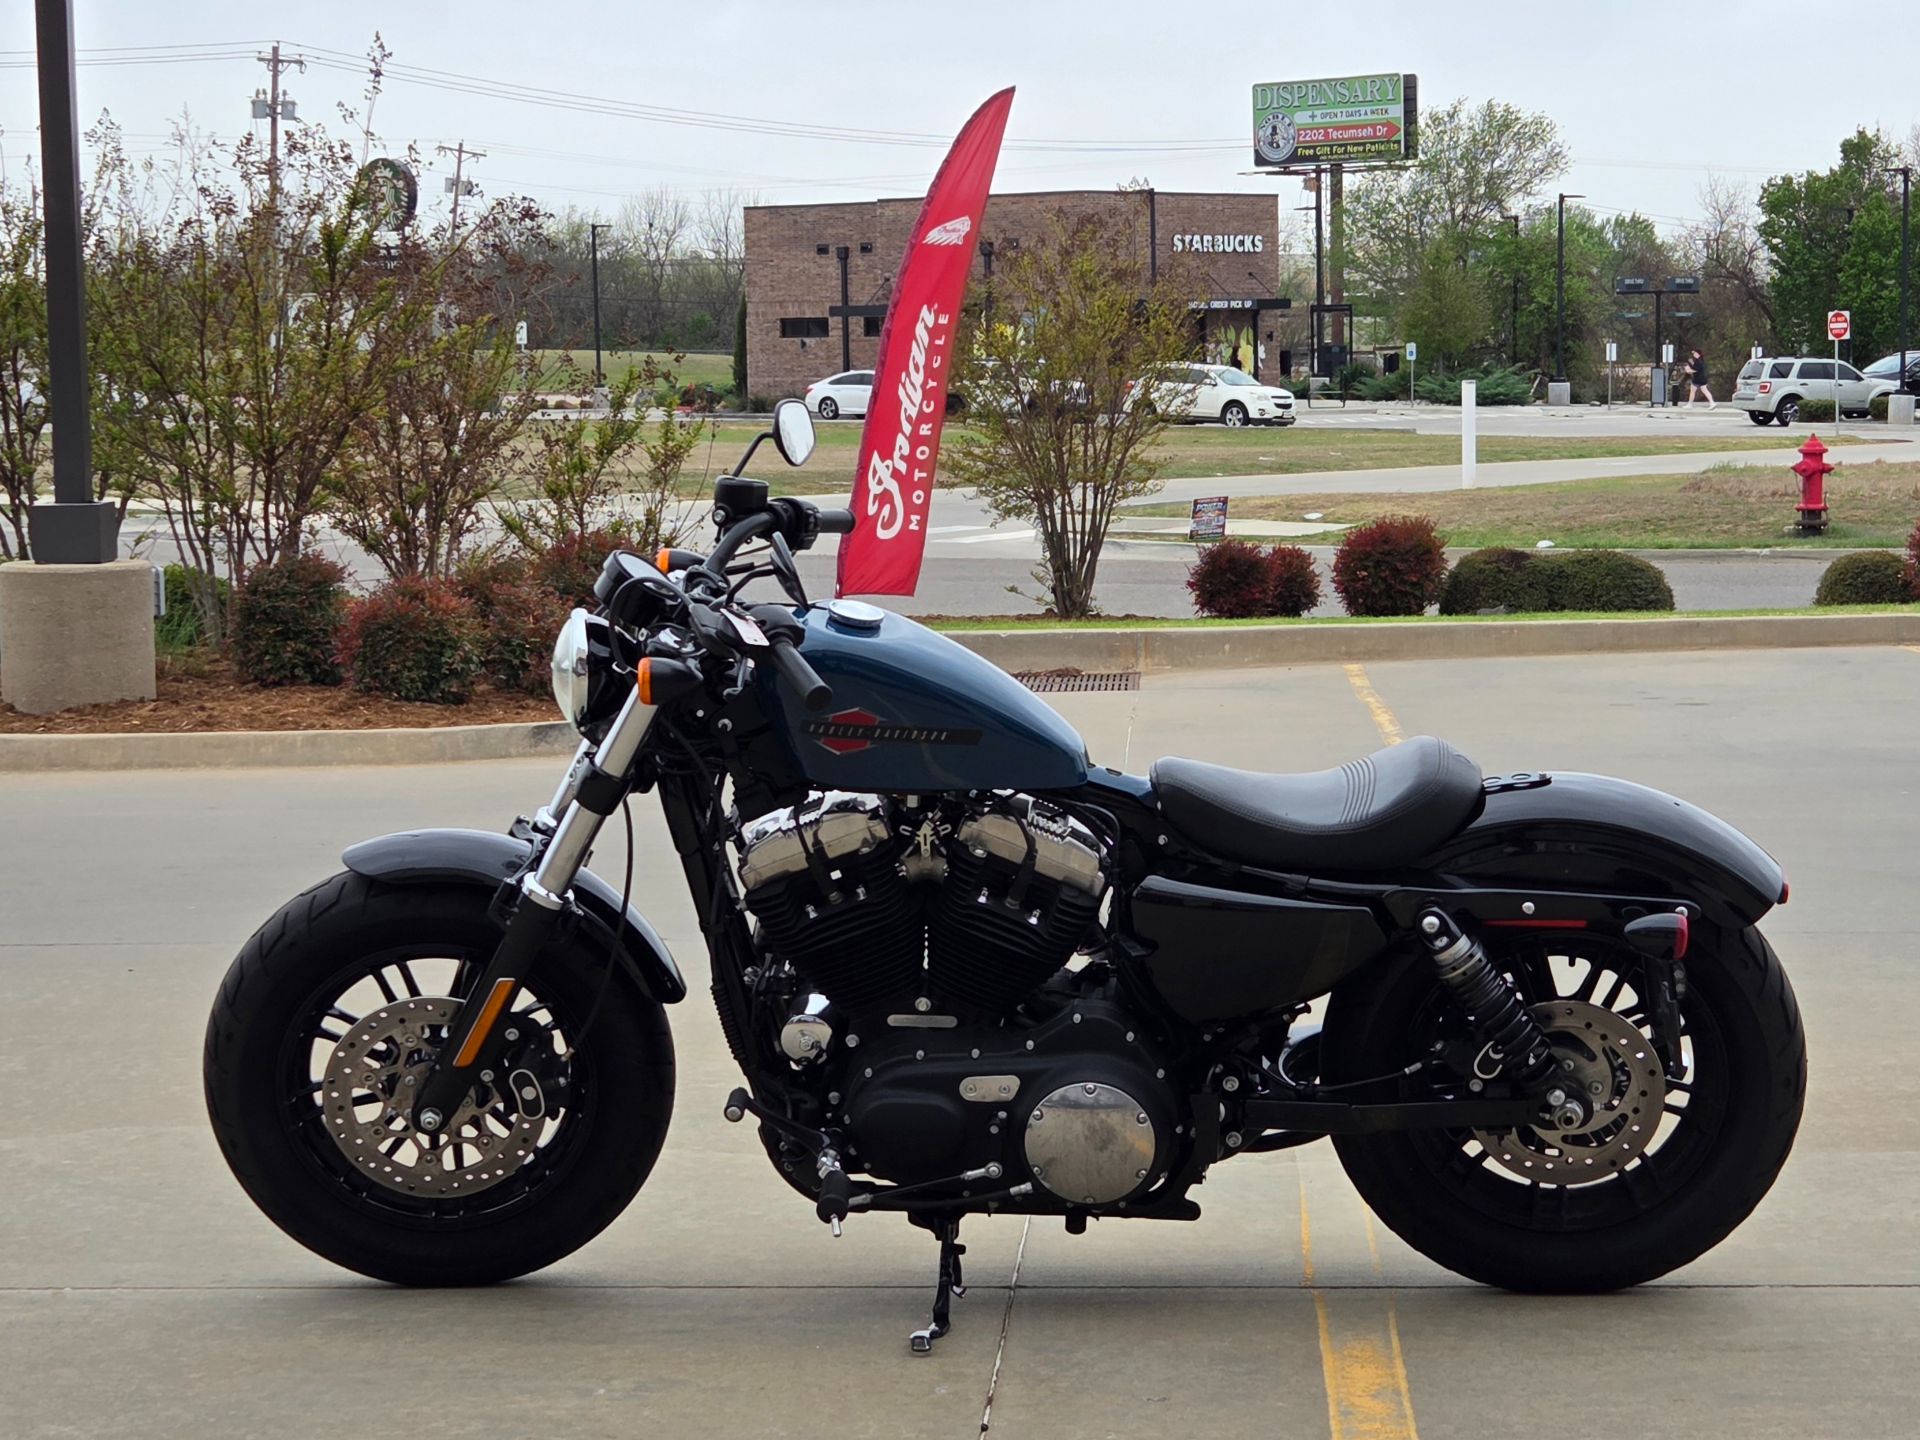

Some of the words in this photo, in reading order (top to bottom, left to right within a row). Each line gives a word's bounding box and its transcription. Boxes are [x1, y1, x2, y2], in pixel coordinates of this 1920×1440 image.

[1255, 76, 1400, 111] DISPENSARY
[1320, 110, 1338, 120] OPEN
[1340, 110, 1345, 118] 7
[1345, 108, 1362, 119] DAYS
[1363, 108, 1369, 117] A
[1370, 107, 1389, 116] WEEK
[1299, 128, 1325, 141] 2202
[1328, 126, 1374, 140] Tecumseh
[1376, 125, 1388, 137] Dr
[1297, 148, 1314, 157] Free
[1316, 146, 1331, 155] Gift
[1333, 145, 1345, 154] For
[1347, 144, 1363, 153] New
[1365, 142, 1398, 152] Patiets
[1173, 234, 1263, 253] STARBUCKS
[867, 303, 936, 540] Indian
[908, 313, 949, 531] MOTORCYCLE
